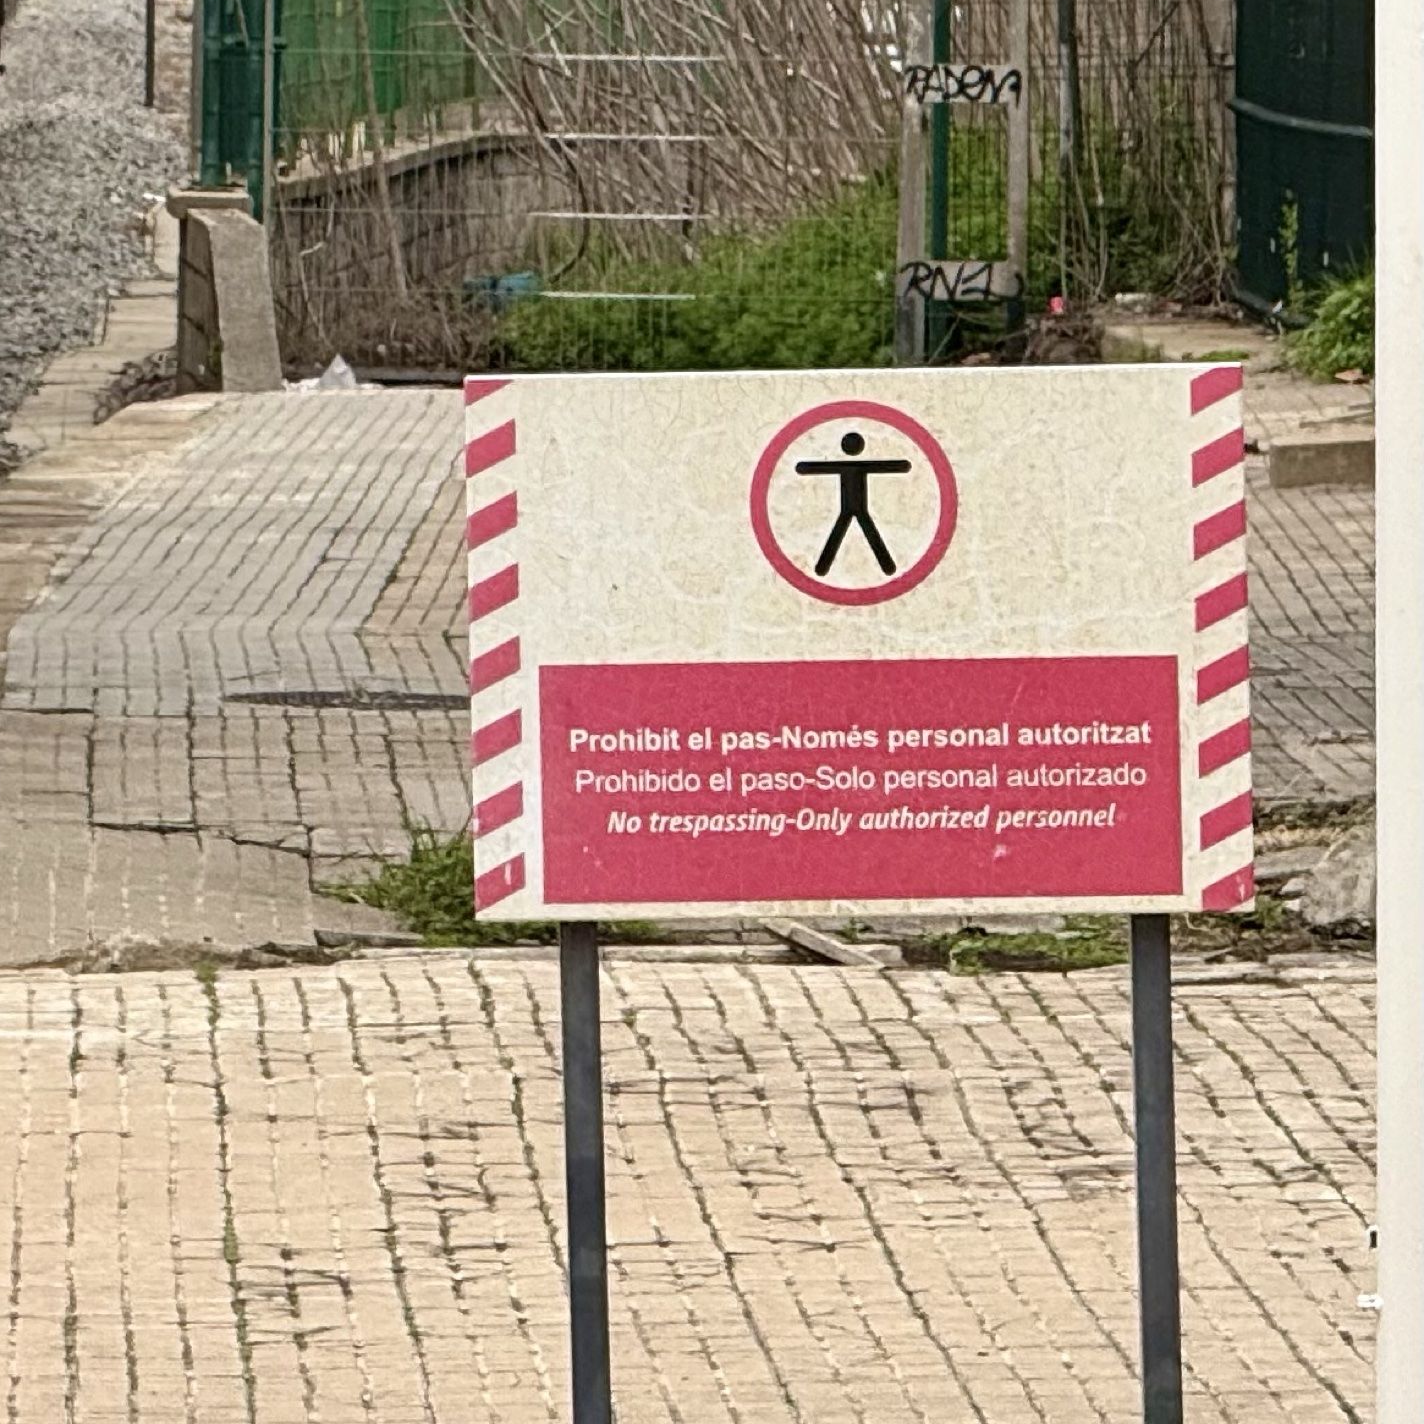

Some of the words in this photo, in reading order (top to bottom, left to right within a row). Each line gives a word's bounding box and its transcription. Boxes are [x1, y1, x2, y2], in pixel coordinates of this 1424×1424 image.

[569, 727, 681, 753] Prohibit
[687, 727, 712, 751] el
[721, 725, 880, 756] pas-Només
[887, 722, 1009, 754] personal
[1017, 720, 1152, 746] autoritzat
[575, 768, 701, 793] Prohibido
[709, 767, 733, 792] el
[740, 765, 876, 797] paso-Solo
[883, 763, 998, 795] personal
[1006, 762, 1148, 787] autorizado
[607, 811, 642, 834] No
[649, 806, 853, 838] trespassing-Only
[858, 804, 991, 831] authorized
[995, 802, 1118, 835] personnel
